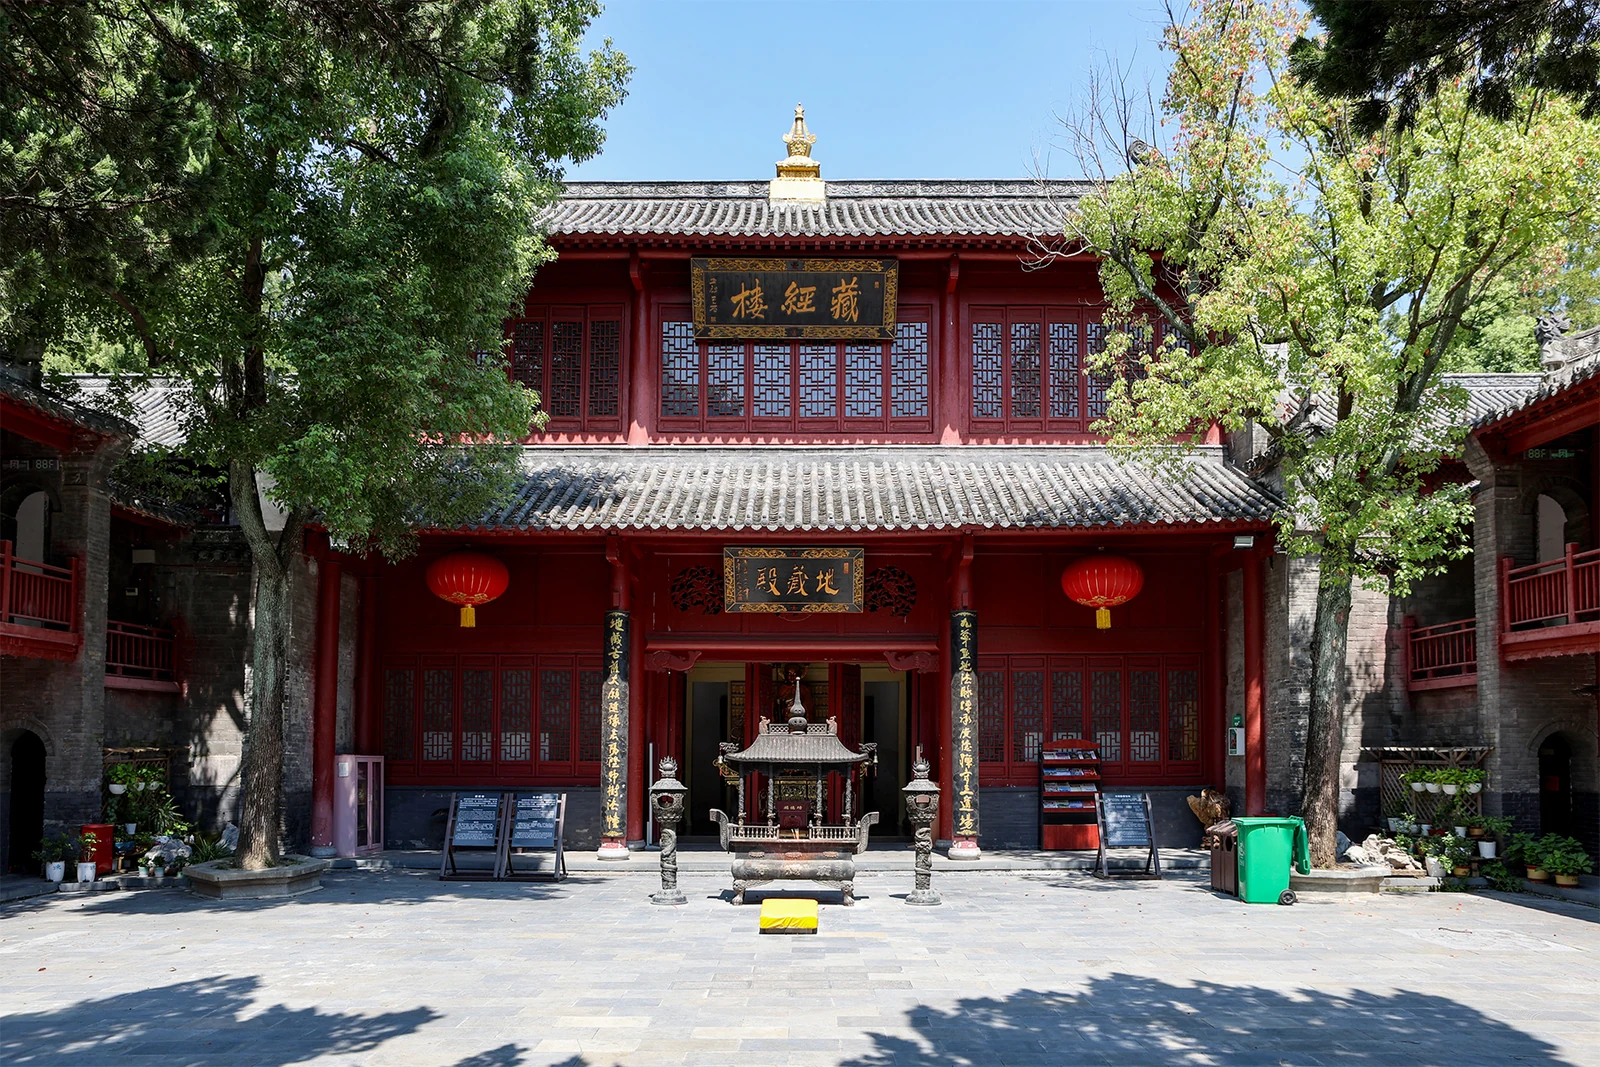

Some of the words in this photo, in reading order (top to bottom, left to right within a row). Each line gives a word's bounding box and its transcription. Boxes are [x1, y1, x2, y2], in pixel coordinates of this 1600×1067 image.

[731, 276, 861, 323] 藏經樓
[754, 563, 840, 597] 地藏殿
